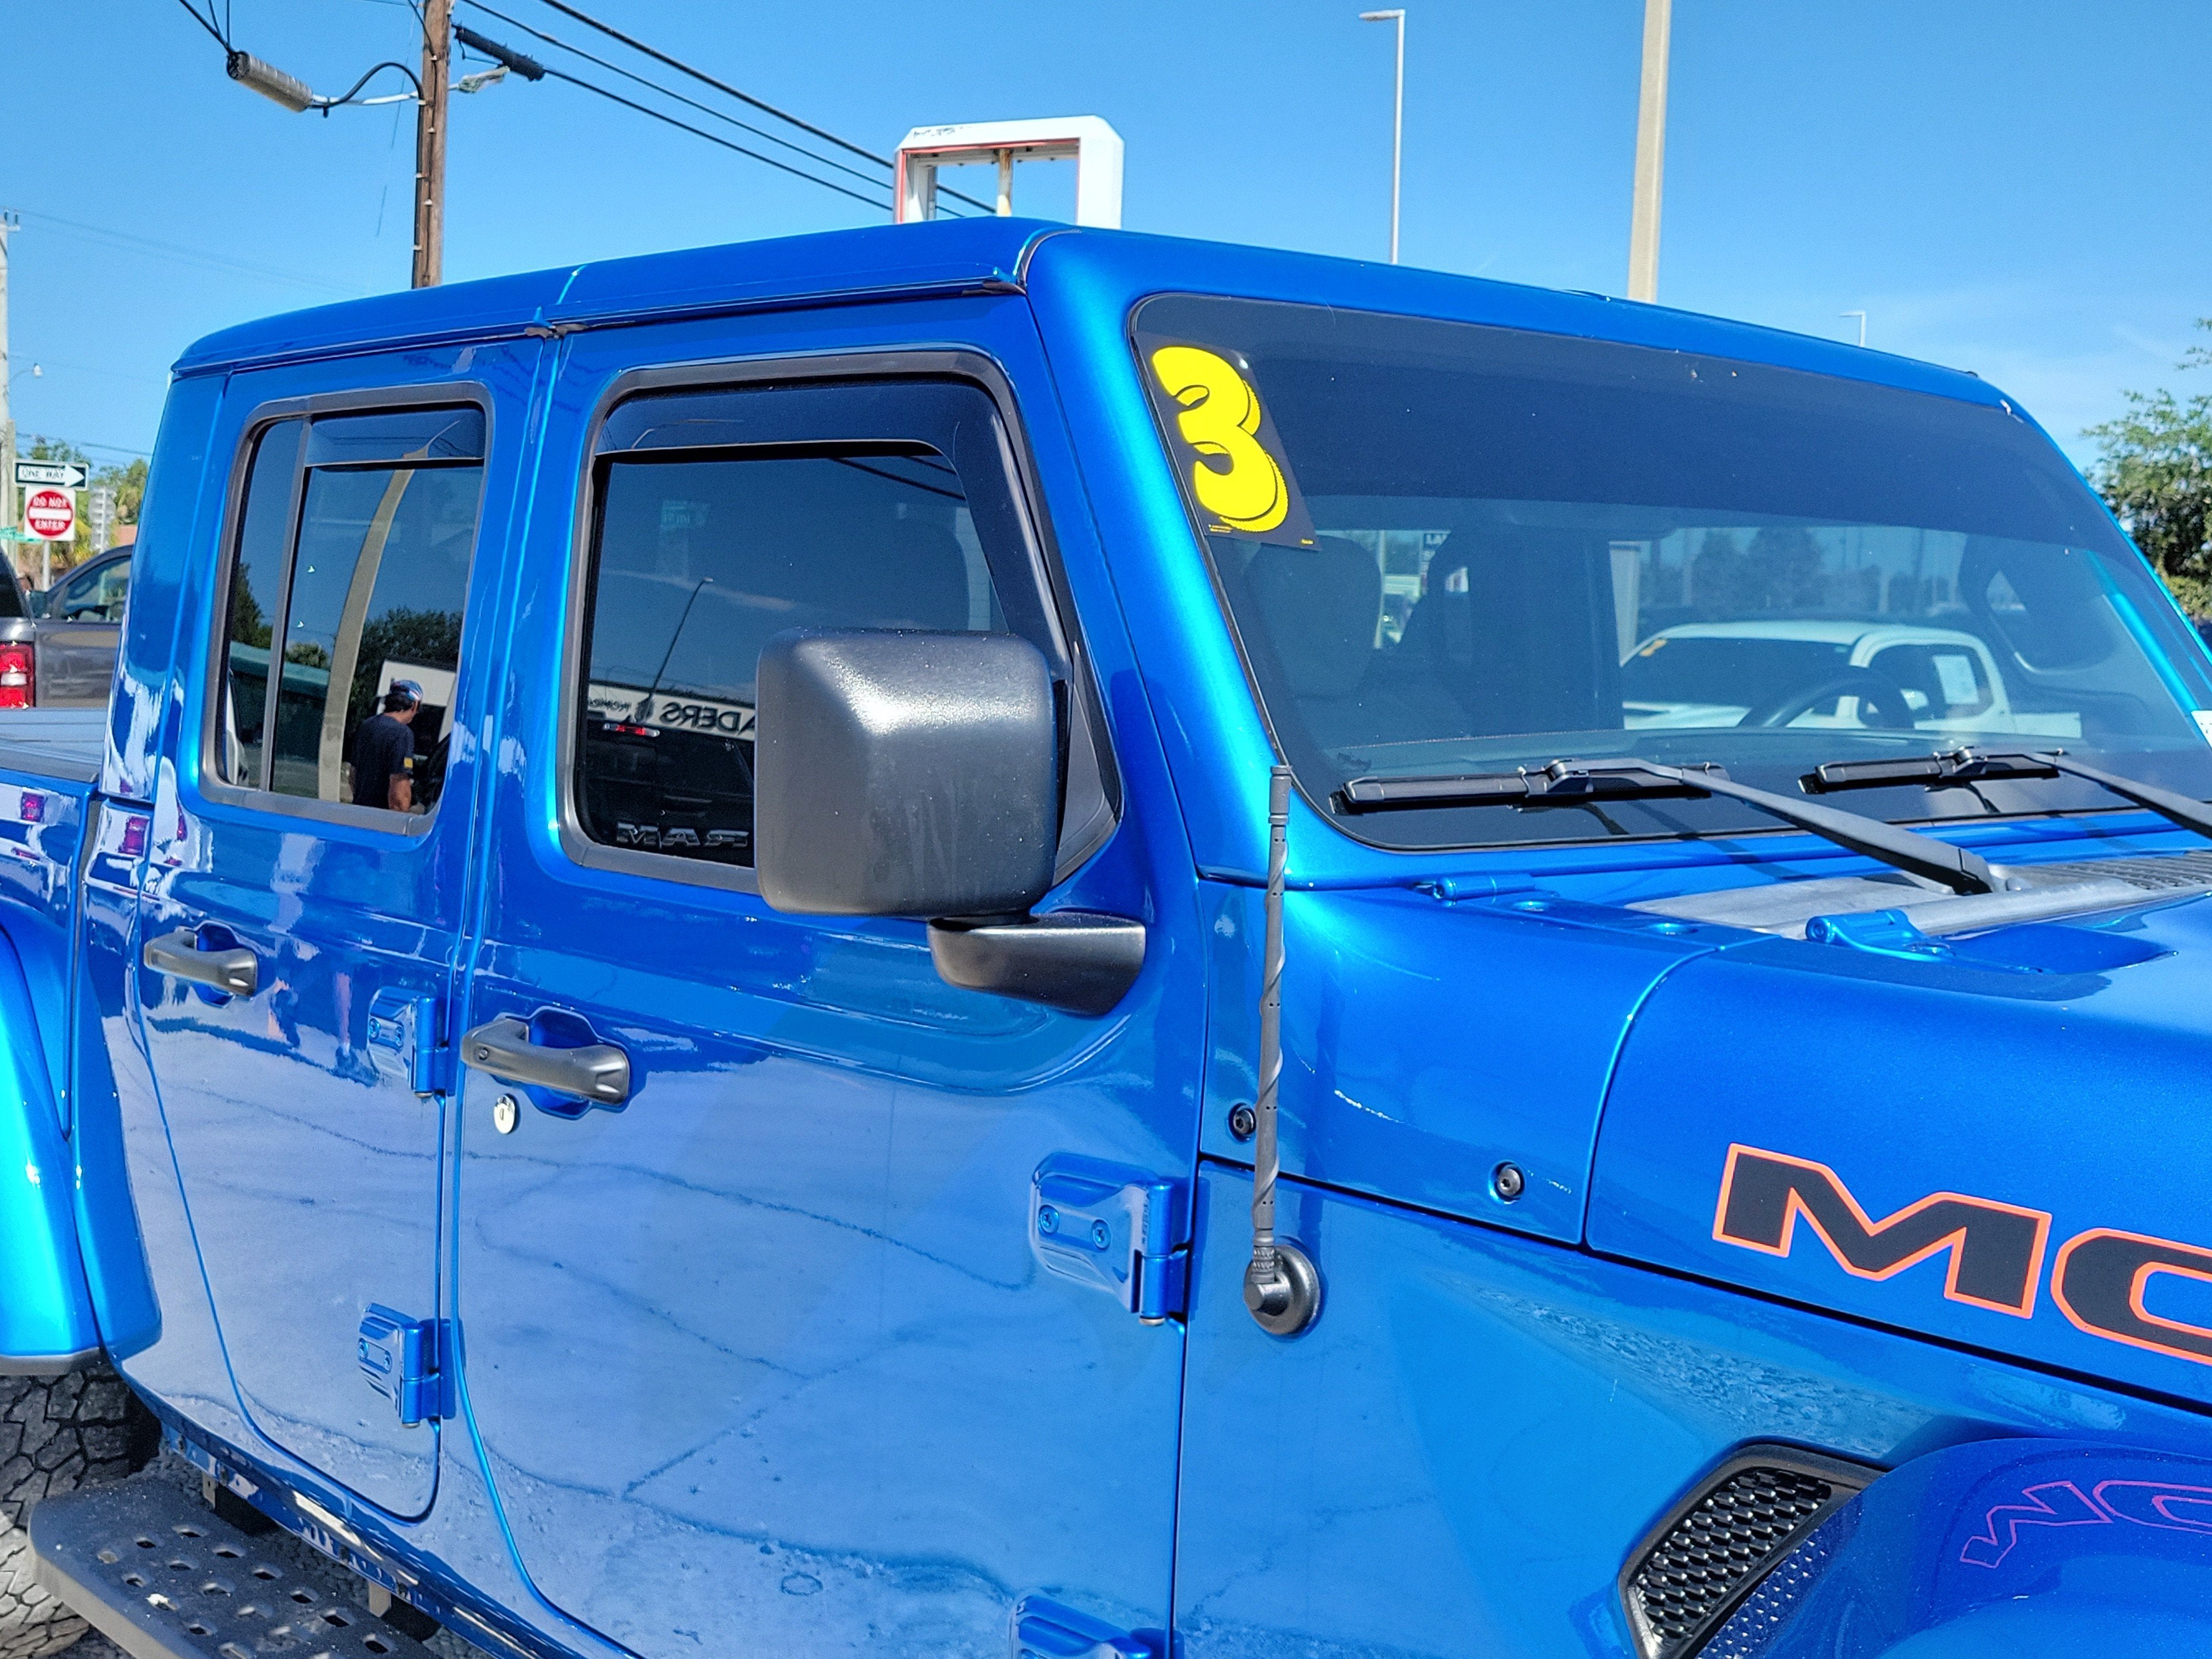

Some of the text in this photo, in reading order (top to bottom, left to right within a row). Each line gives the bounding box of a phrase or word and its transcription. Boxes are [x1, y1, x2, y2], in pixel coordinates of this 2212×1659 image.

[1153, 347, 1288, 532] 3
[22, 467, 64, 479] ONE WAY
[33, 495, 67, 508] DO NOT
[35, 519, 66, 531] ENTER
